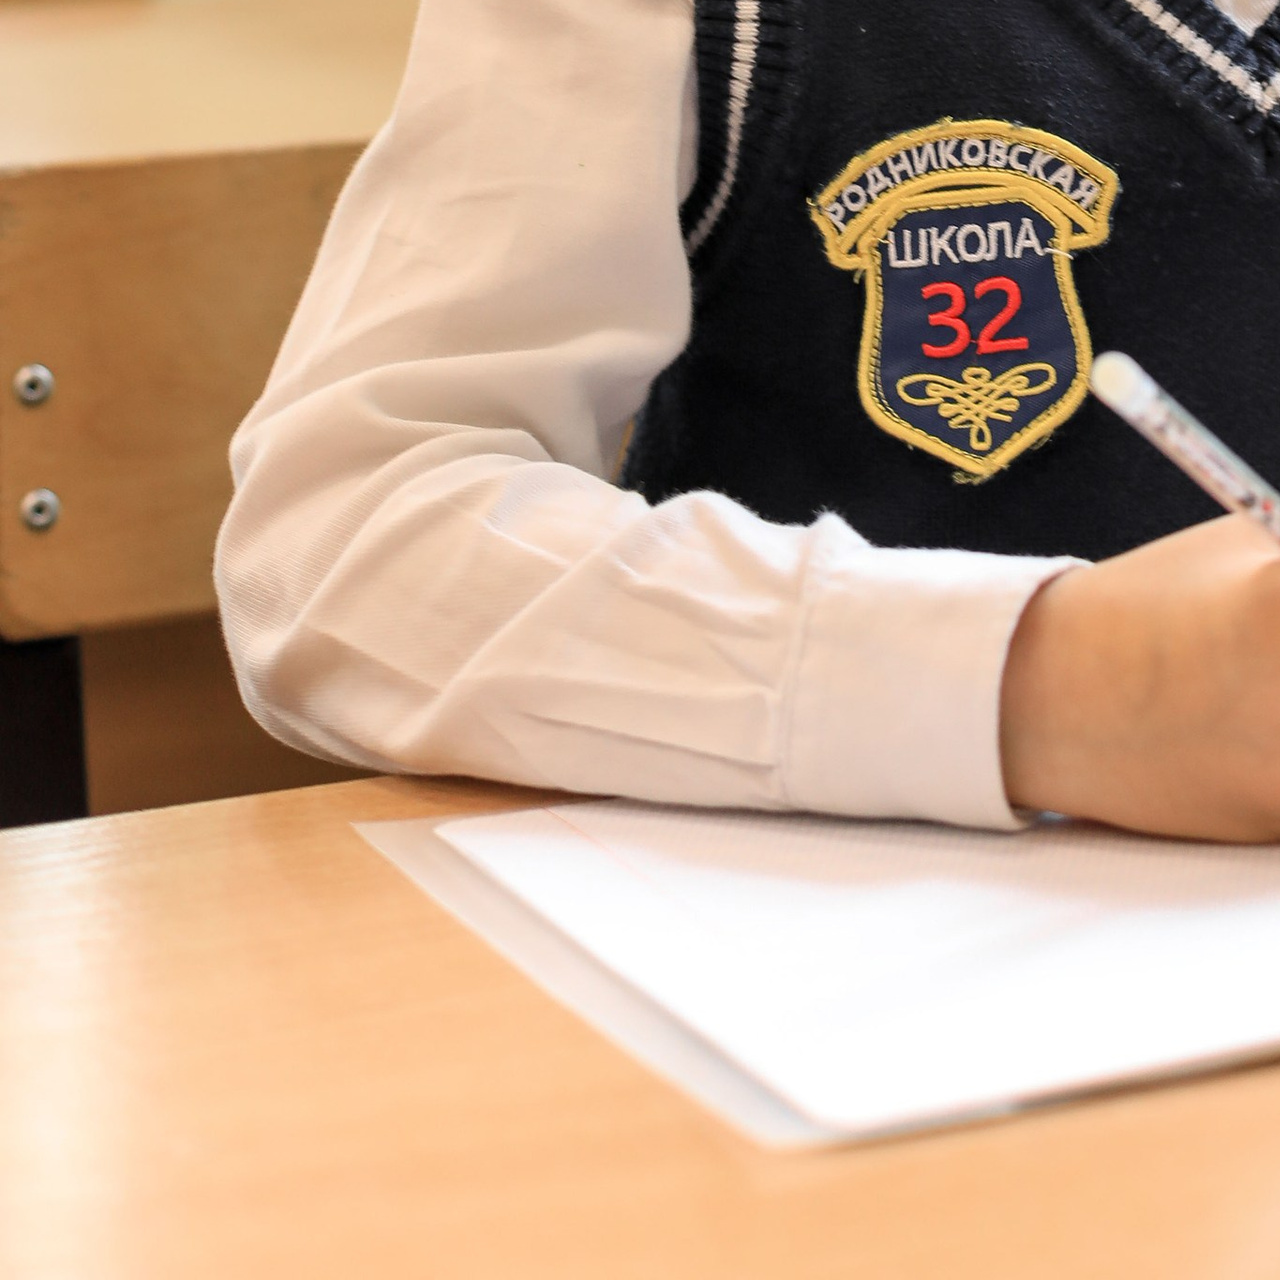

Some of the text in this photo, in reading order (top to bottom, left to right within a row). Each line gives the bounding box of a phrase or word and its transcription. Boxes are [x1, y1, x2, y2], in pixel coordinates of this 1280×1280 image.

[827, 139, 1100, 229] РОДНИКОВСКАЯ
[887, 218, 1045, 268] ШКОЛА
[921, 276, 1029, 358] 32
